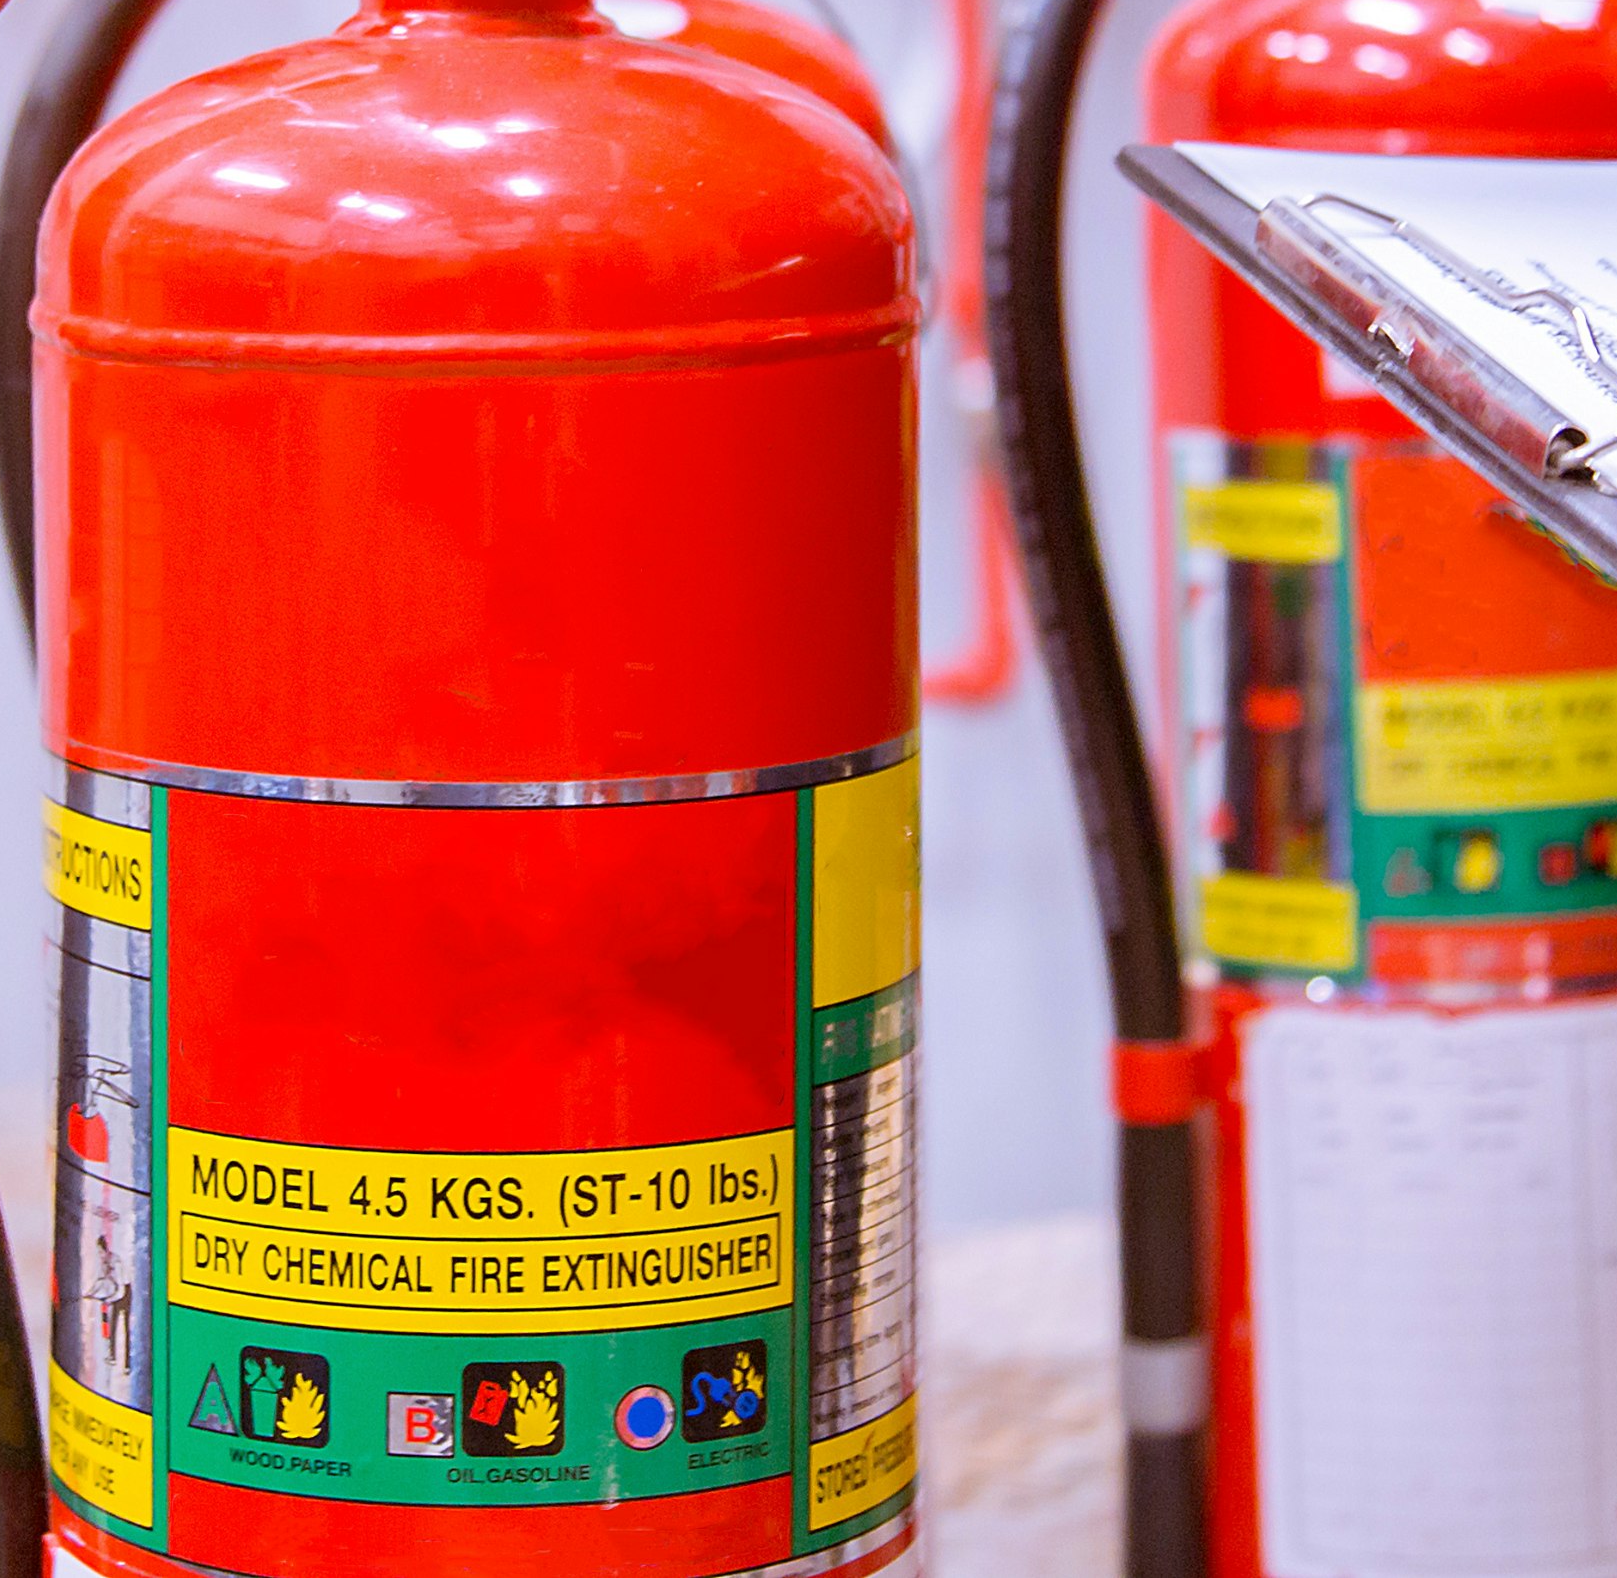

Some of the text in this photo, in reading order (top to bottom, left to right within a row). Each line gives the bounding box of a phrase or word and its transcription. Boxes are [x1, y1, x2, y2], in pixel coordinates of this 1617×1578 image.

[192, 1154, 329, 1213] MODEL
[349, 1175, 407, 1218] 4.5
[430, 1176, 534, 1220] KGS.
[559, 1167, 691, 1228] (ST-10
[709, 1153, 778, 1207] lbs.)
[194, 1232, 249, 1275] DRY
[262, 1243, 433, 1293] CHEMICAL
[450, 1255, 525, 1294] FIRE
[543, 1232, 772, 1293] EXTINGUISHER
[406, 1407, 436, 1443] B
[687, 1440, 771, 1471] ELECTRIC
